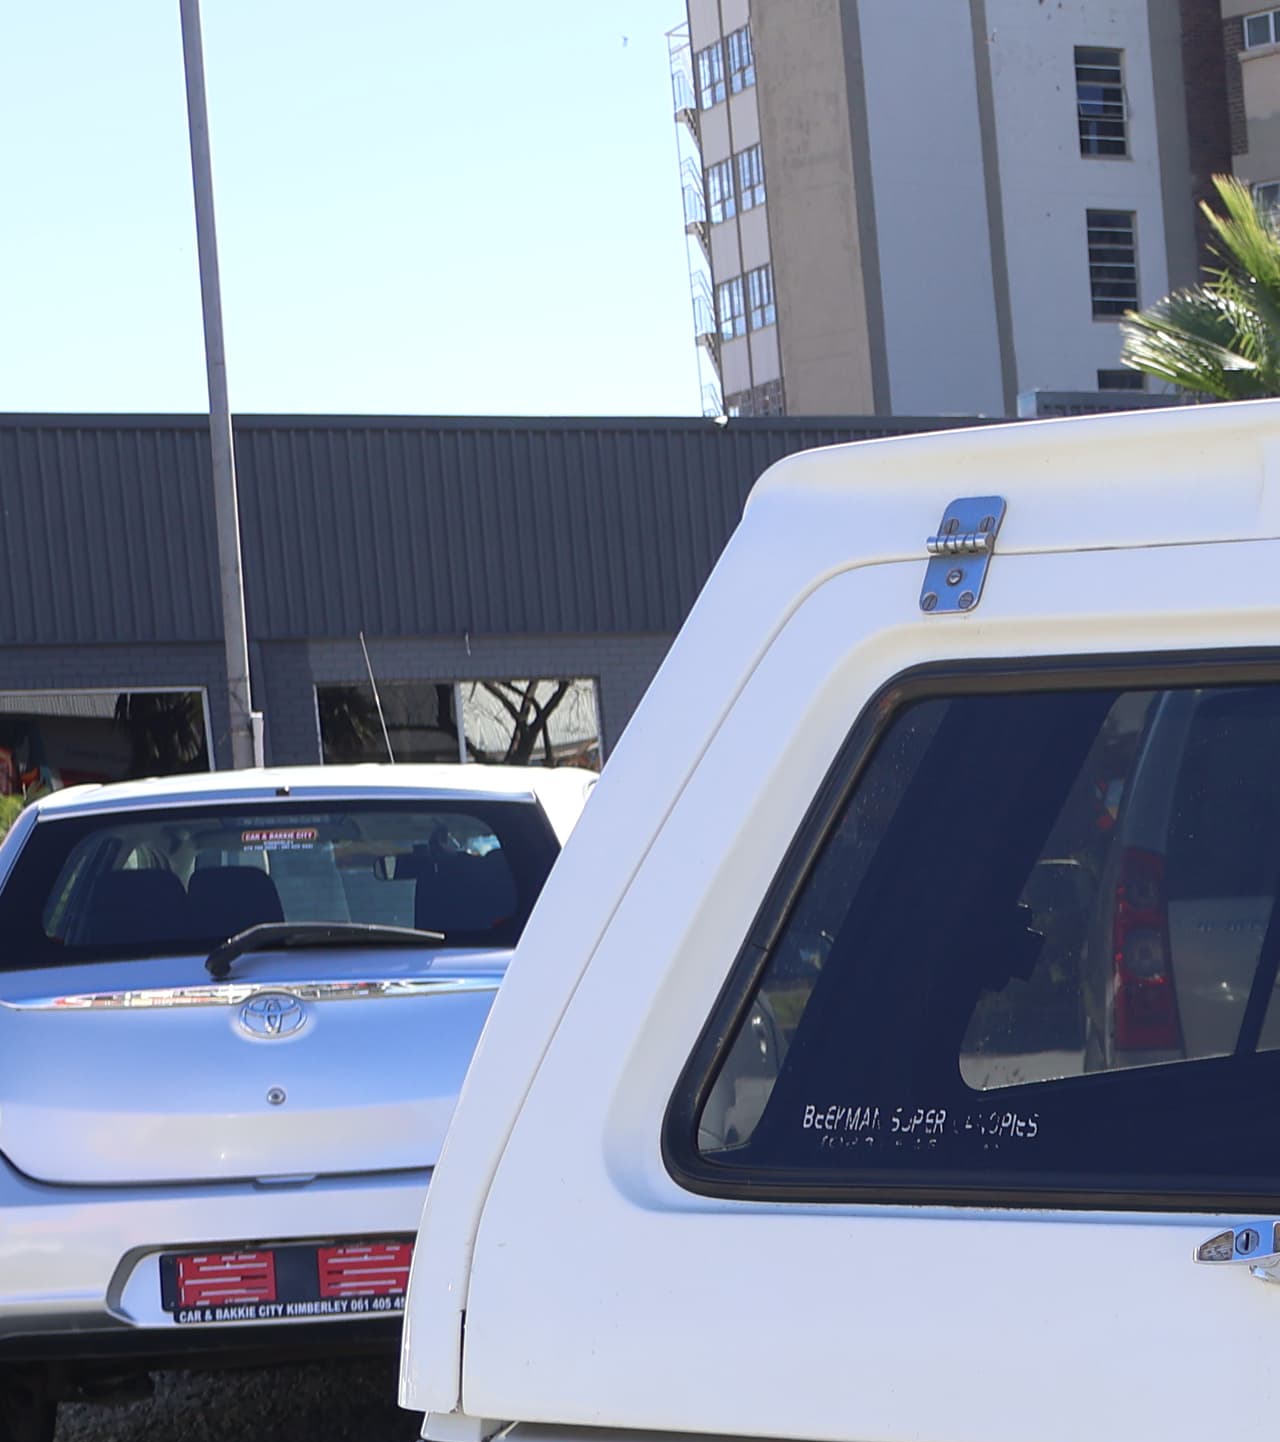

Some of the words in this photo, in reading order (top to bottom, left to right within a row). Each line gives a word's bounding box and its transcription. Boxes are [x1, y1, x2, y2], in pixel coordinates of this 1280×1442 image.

[891, 1108, 946, 1133] SUPER
[179, 1310, 201, 1322] CAR
[205, 1309, 212, 1321] &
[216, 1305, 256, 1320] BAKKIE
[259, 1304, 284, 1317] CITY
[286, 1299, 348, 1315] KIMBERLEY
[351, 1299, 369, 1311] 061
[372, 1297, 391, 1310] 405
